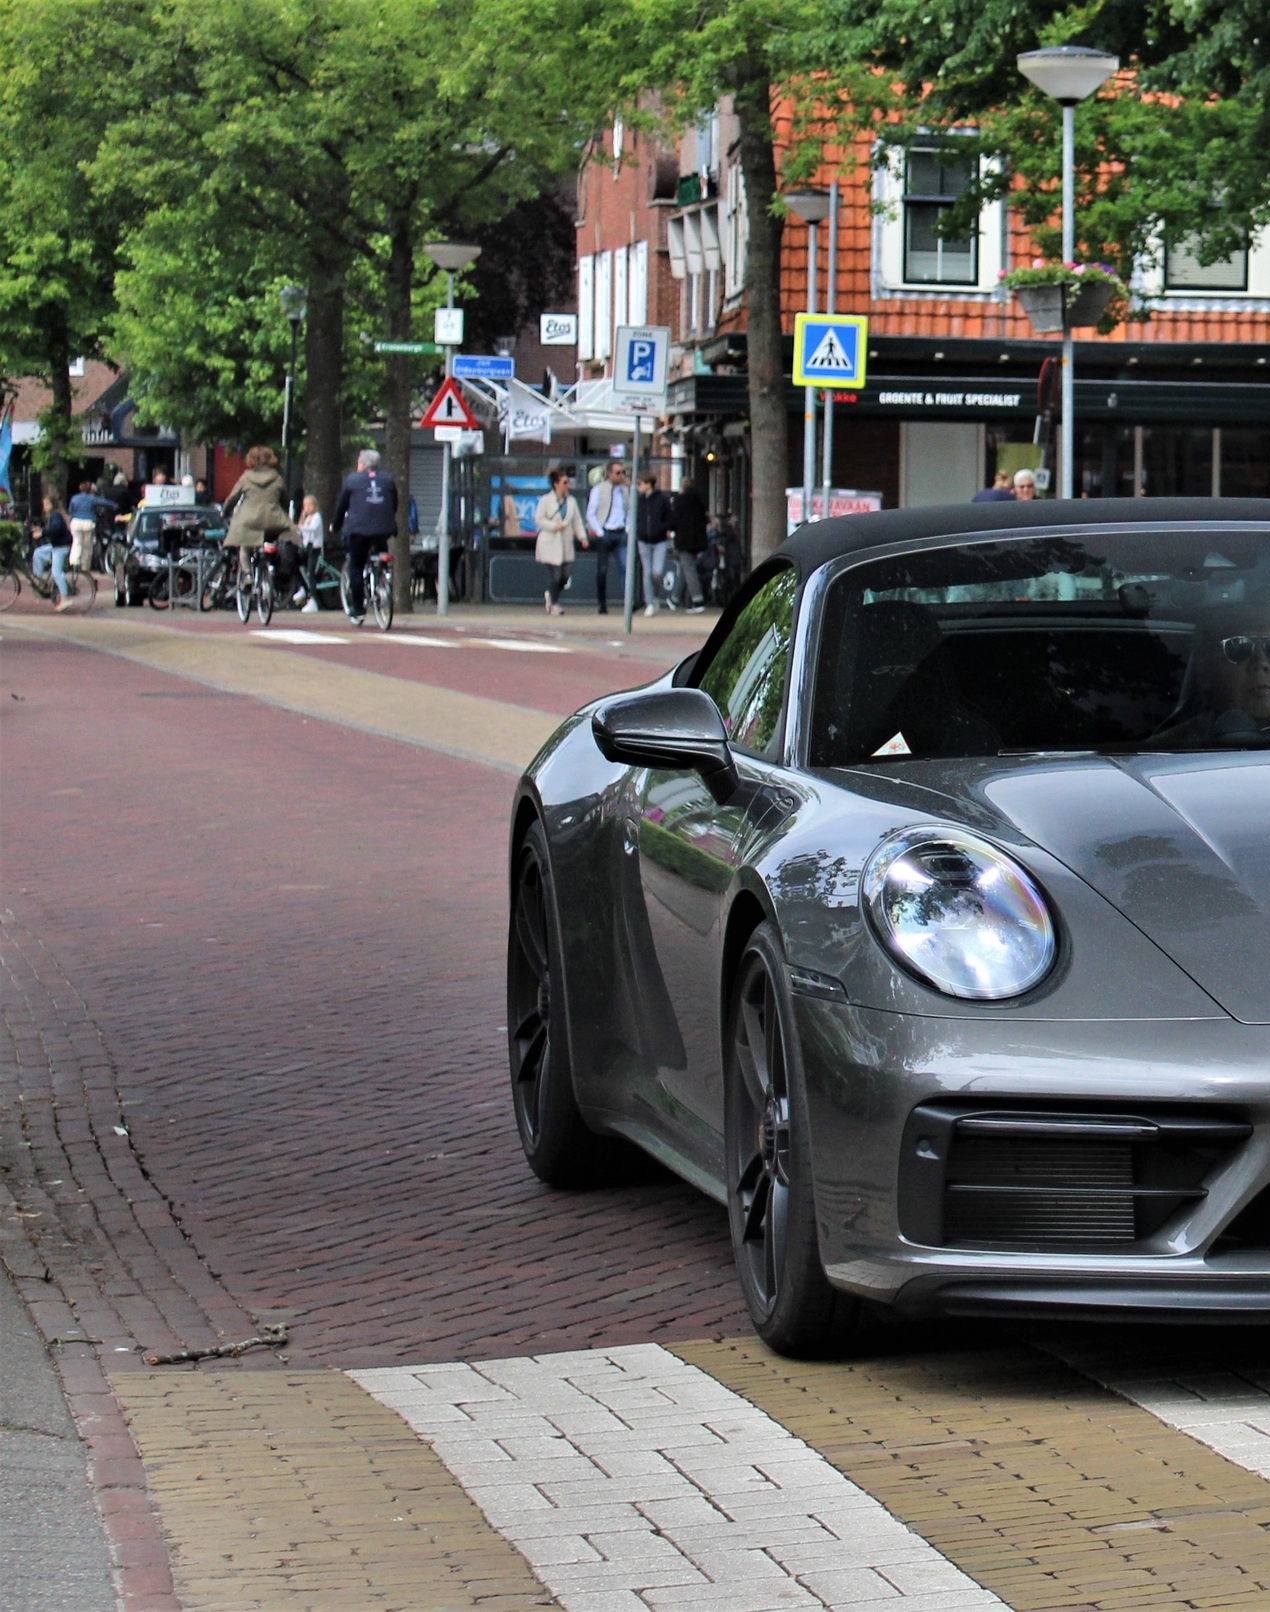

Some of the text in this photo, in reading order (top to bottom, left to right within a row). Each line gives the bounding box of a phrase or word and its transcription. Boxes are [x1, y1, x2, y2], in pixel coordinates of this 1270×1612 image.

[546, 319, 571, 336] Etos
[632, 330, 653, 338] ZONE
[633, 342, 651, 366] P
[878, 392, 924, 405] GROENTE
[924, 392, 934, 405] &
[935, 393, 964, 405] FRUIT
[965, 393, 1020, 407] SPECIALIST
